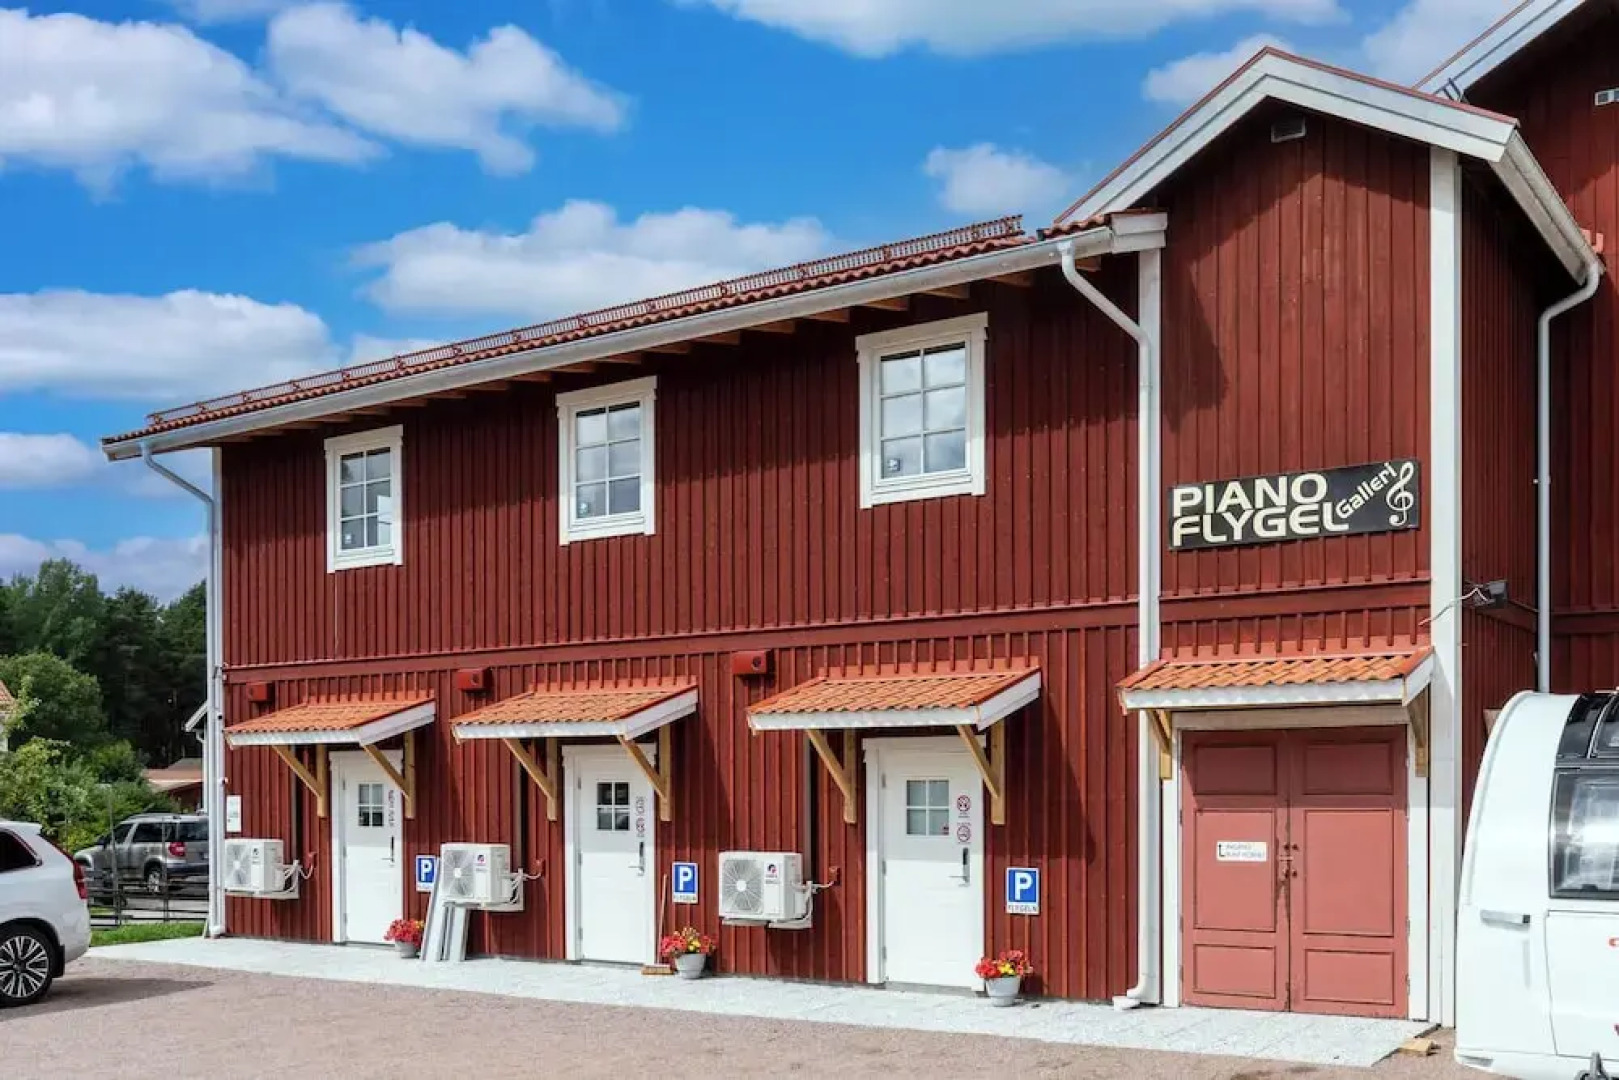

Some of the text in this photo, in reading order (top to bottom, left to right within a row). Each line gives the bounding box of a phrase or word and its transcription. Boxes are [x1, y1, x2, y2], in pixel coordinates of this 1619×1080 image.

[1172, 472, 1328, 518] PIANO
[1335, 461, 1398, 519] Galleri
[1172, 501, 1350, 547] FLYGEL
[420, 859, 433, 882] P
[679, 865, 692, 892] P
[1014, 871, 1034, 901] P
